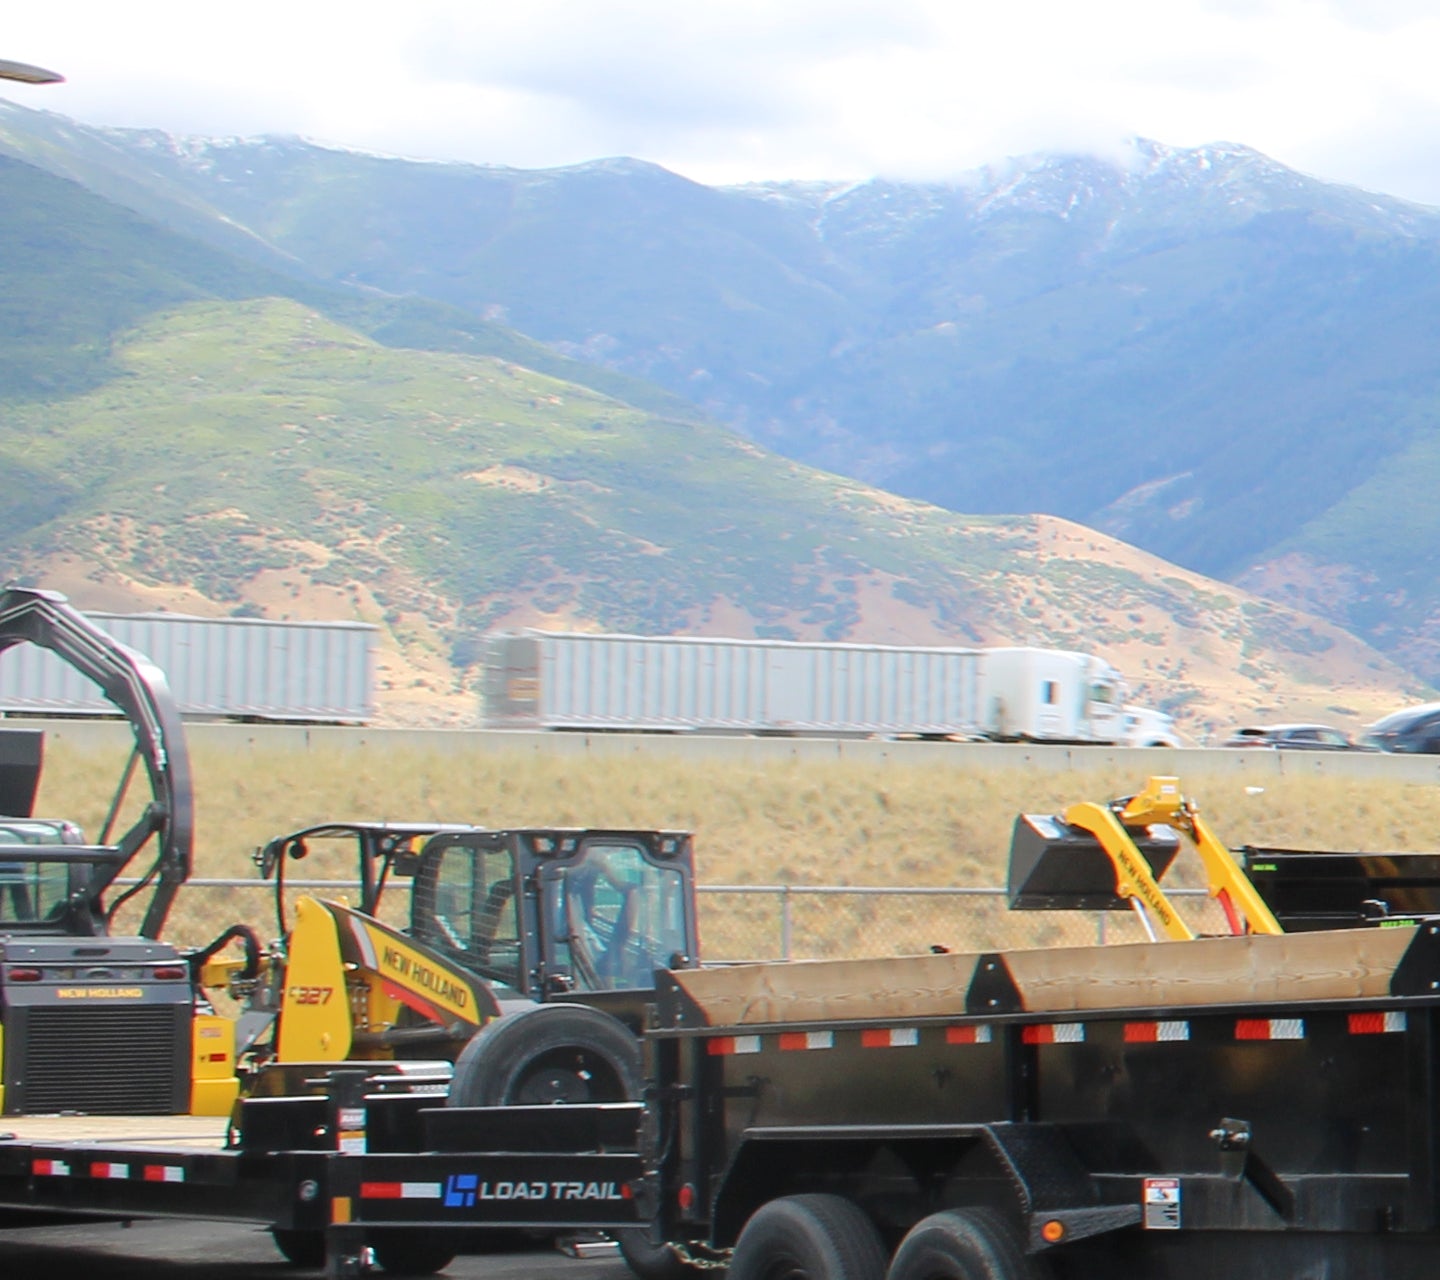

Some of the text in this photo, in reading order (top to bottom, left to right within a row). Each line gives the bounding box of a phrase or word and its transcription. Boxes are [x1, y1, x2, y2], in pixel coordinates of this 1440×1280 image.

[384, 945, 468, 1009] NEW HOLLAND
[58, 987, 143, 999] NEW HOLLAND
[479, 1181, 623, 1201] LOAD TRAIL
